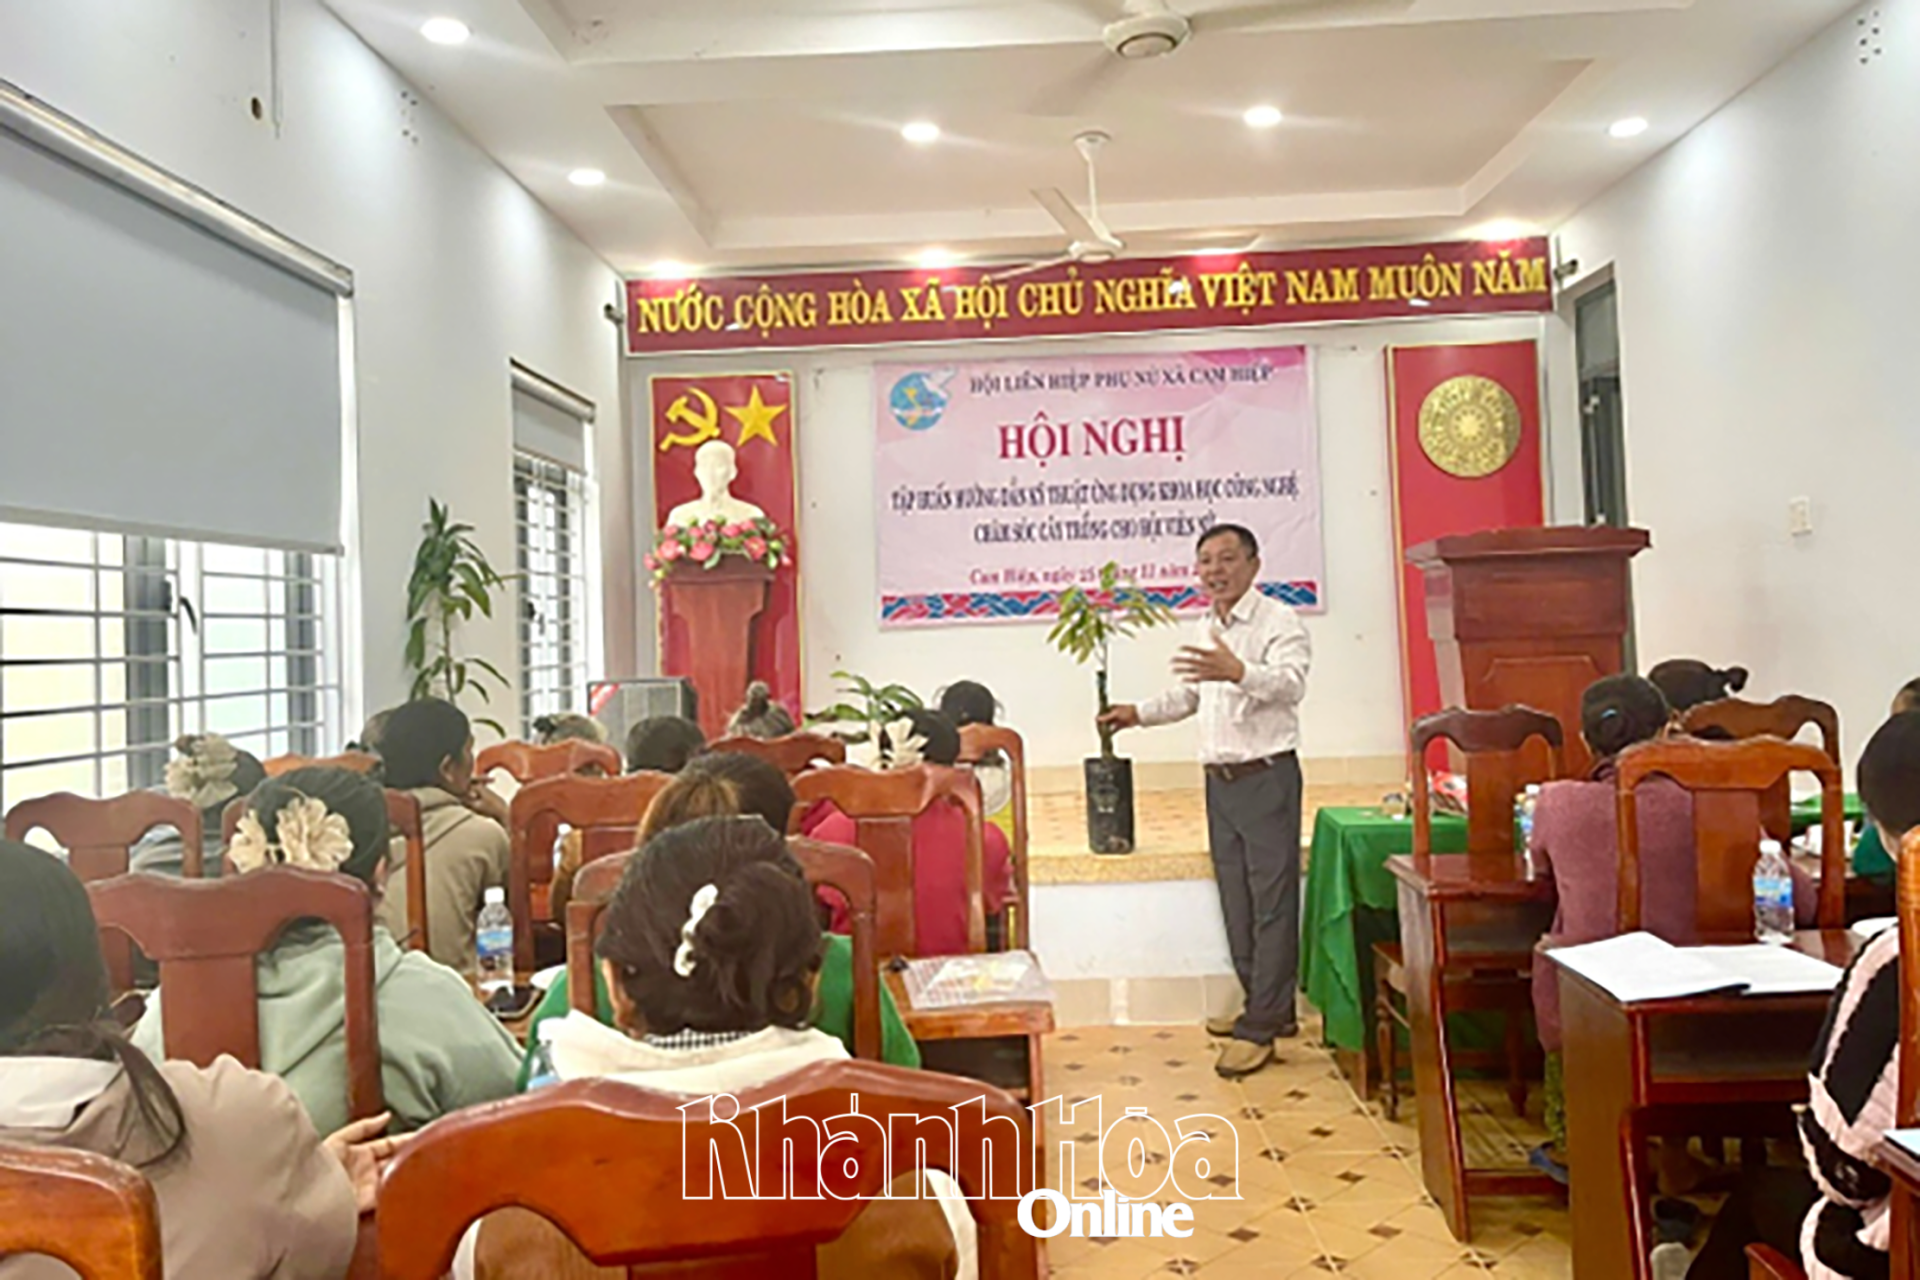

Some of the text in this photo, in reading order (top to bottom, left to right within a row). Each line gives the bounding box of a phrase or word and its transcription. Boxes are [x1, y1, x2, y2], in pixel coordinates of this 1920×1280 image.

[638, 249, 1547, 338] NƯỚC CỘNG HÒA XÃ HỘI CHỦ NGHĨA VIỆT NAM MUÔN NĂM
[999, 411, 1184, 467] HỘI NGHỊ
